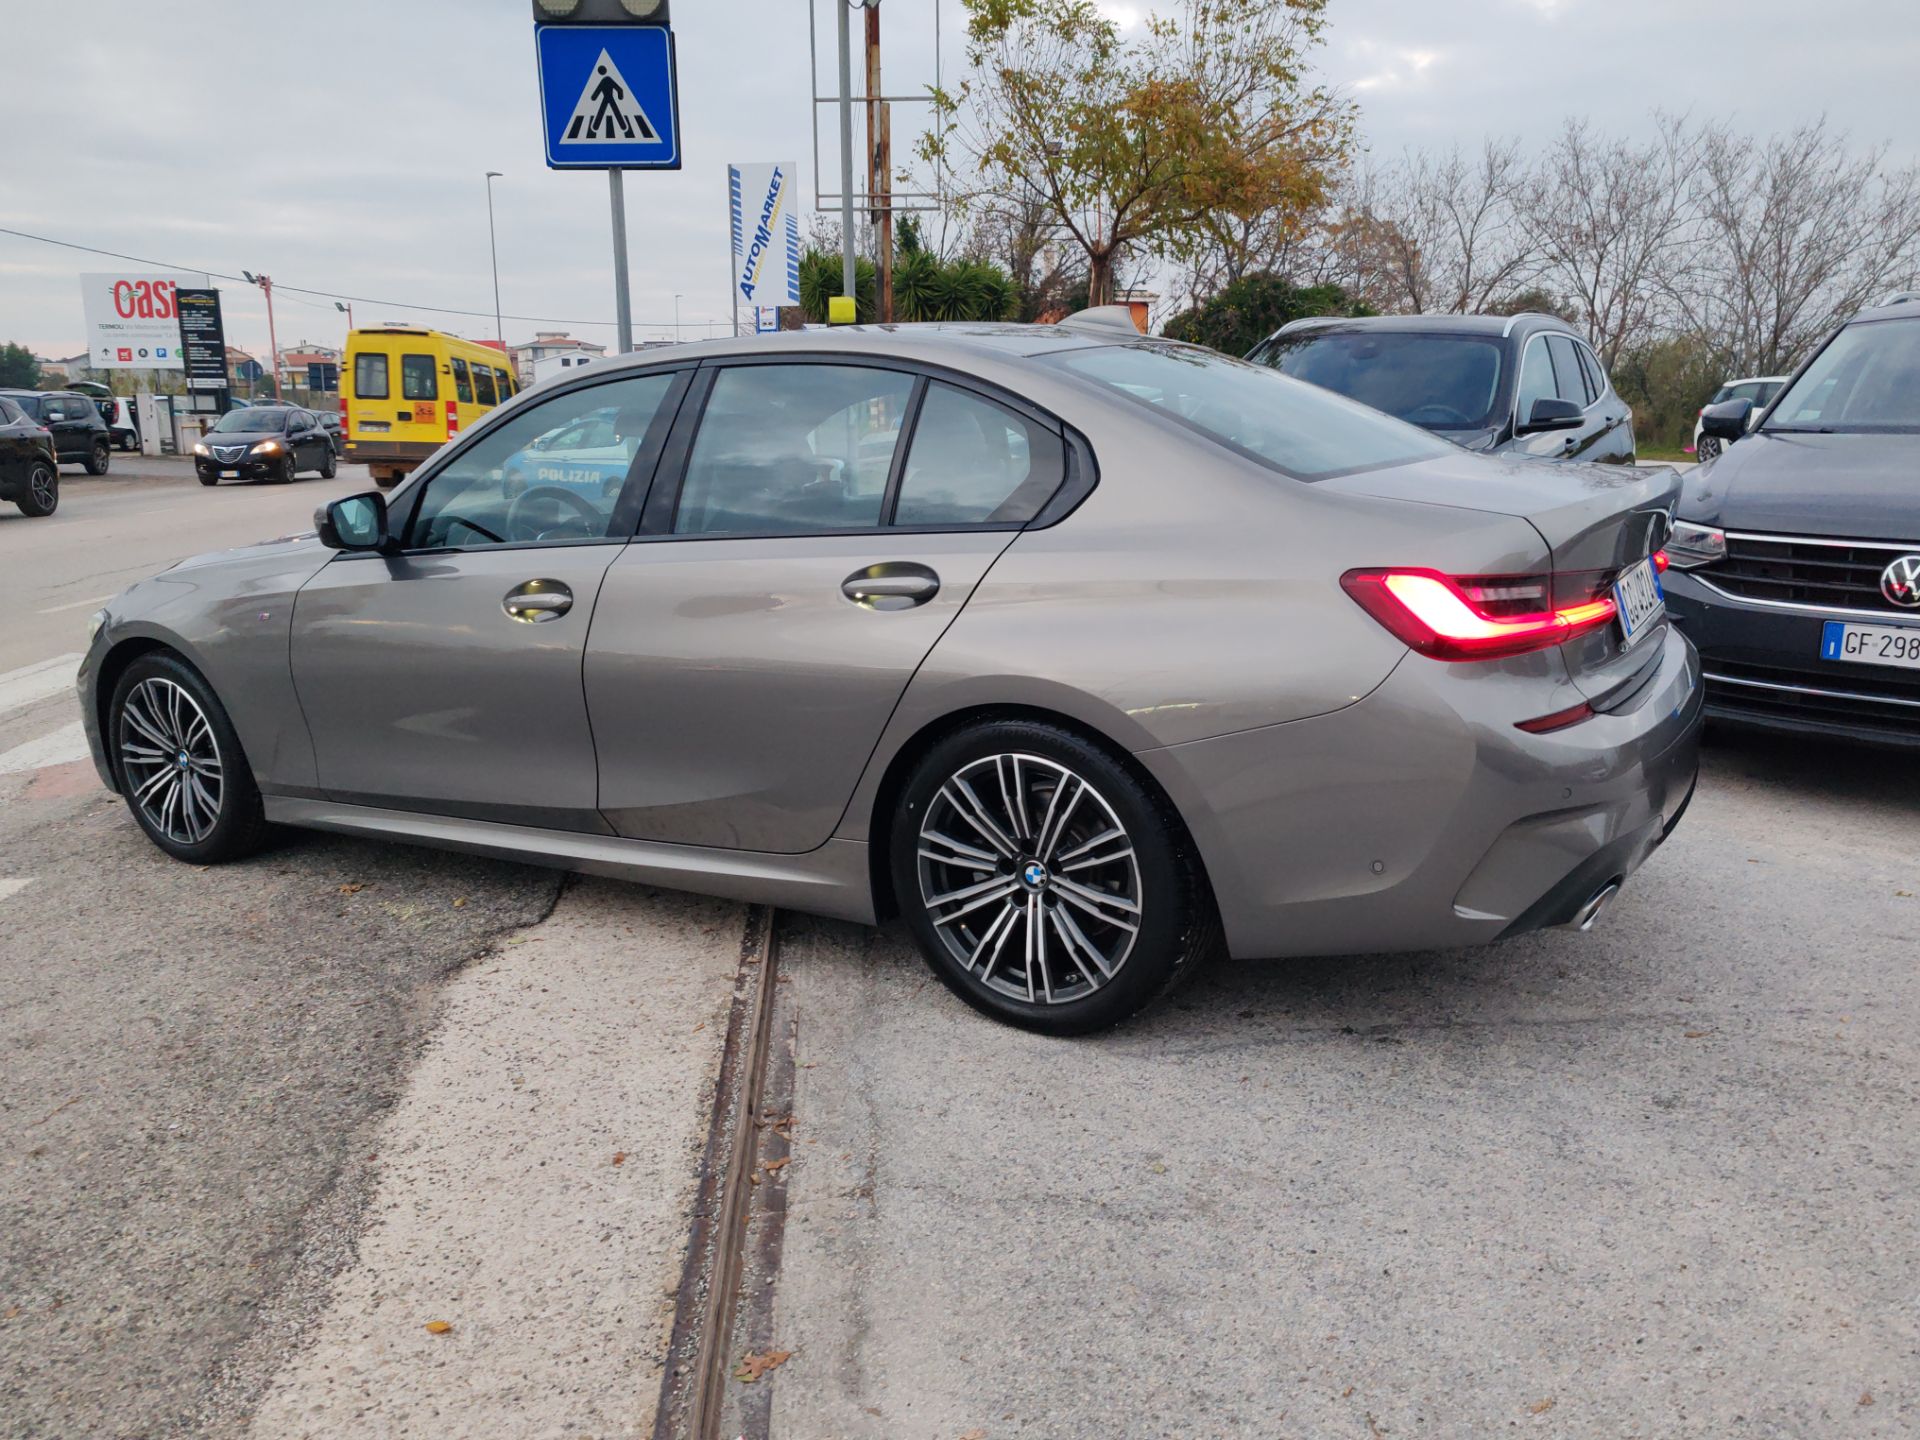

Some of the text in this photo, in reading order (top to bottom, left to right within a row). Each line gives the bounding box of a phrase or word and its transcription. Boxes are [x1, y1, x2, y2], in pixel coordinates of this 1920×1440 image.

[537, 468, 601, 484] POLIZIA
[1845, 631, 1873, 655] GF
[1878, 634, 1920, 660] 298
